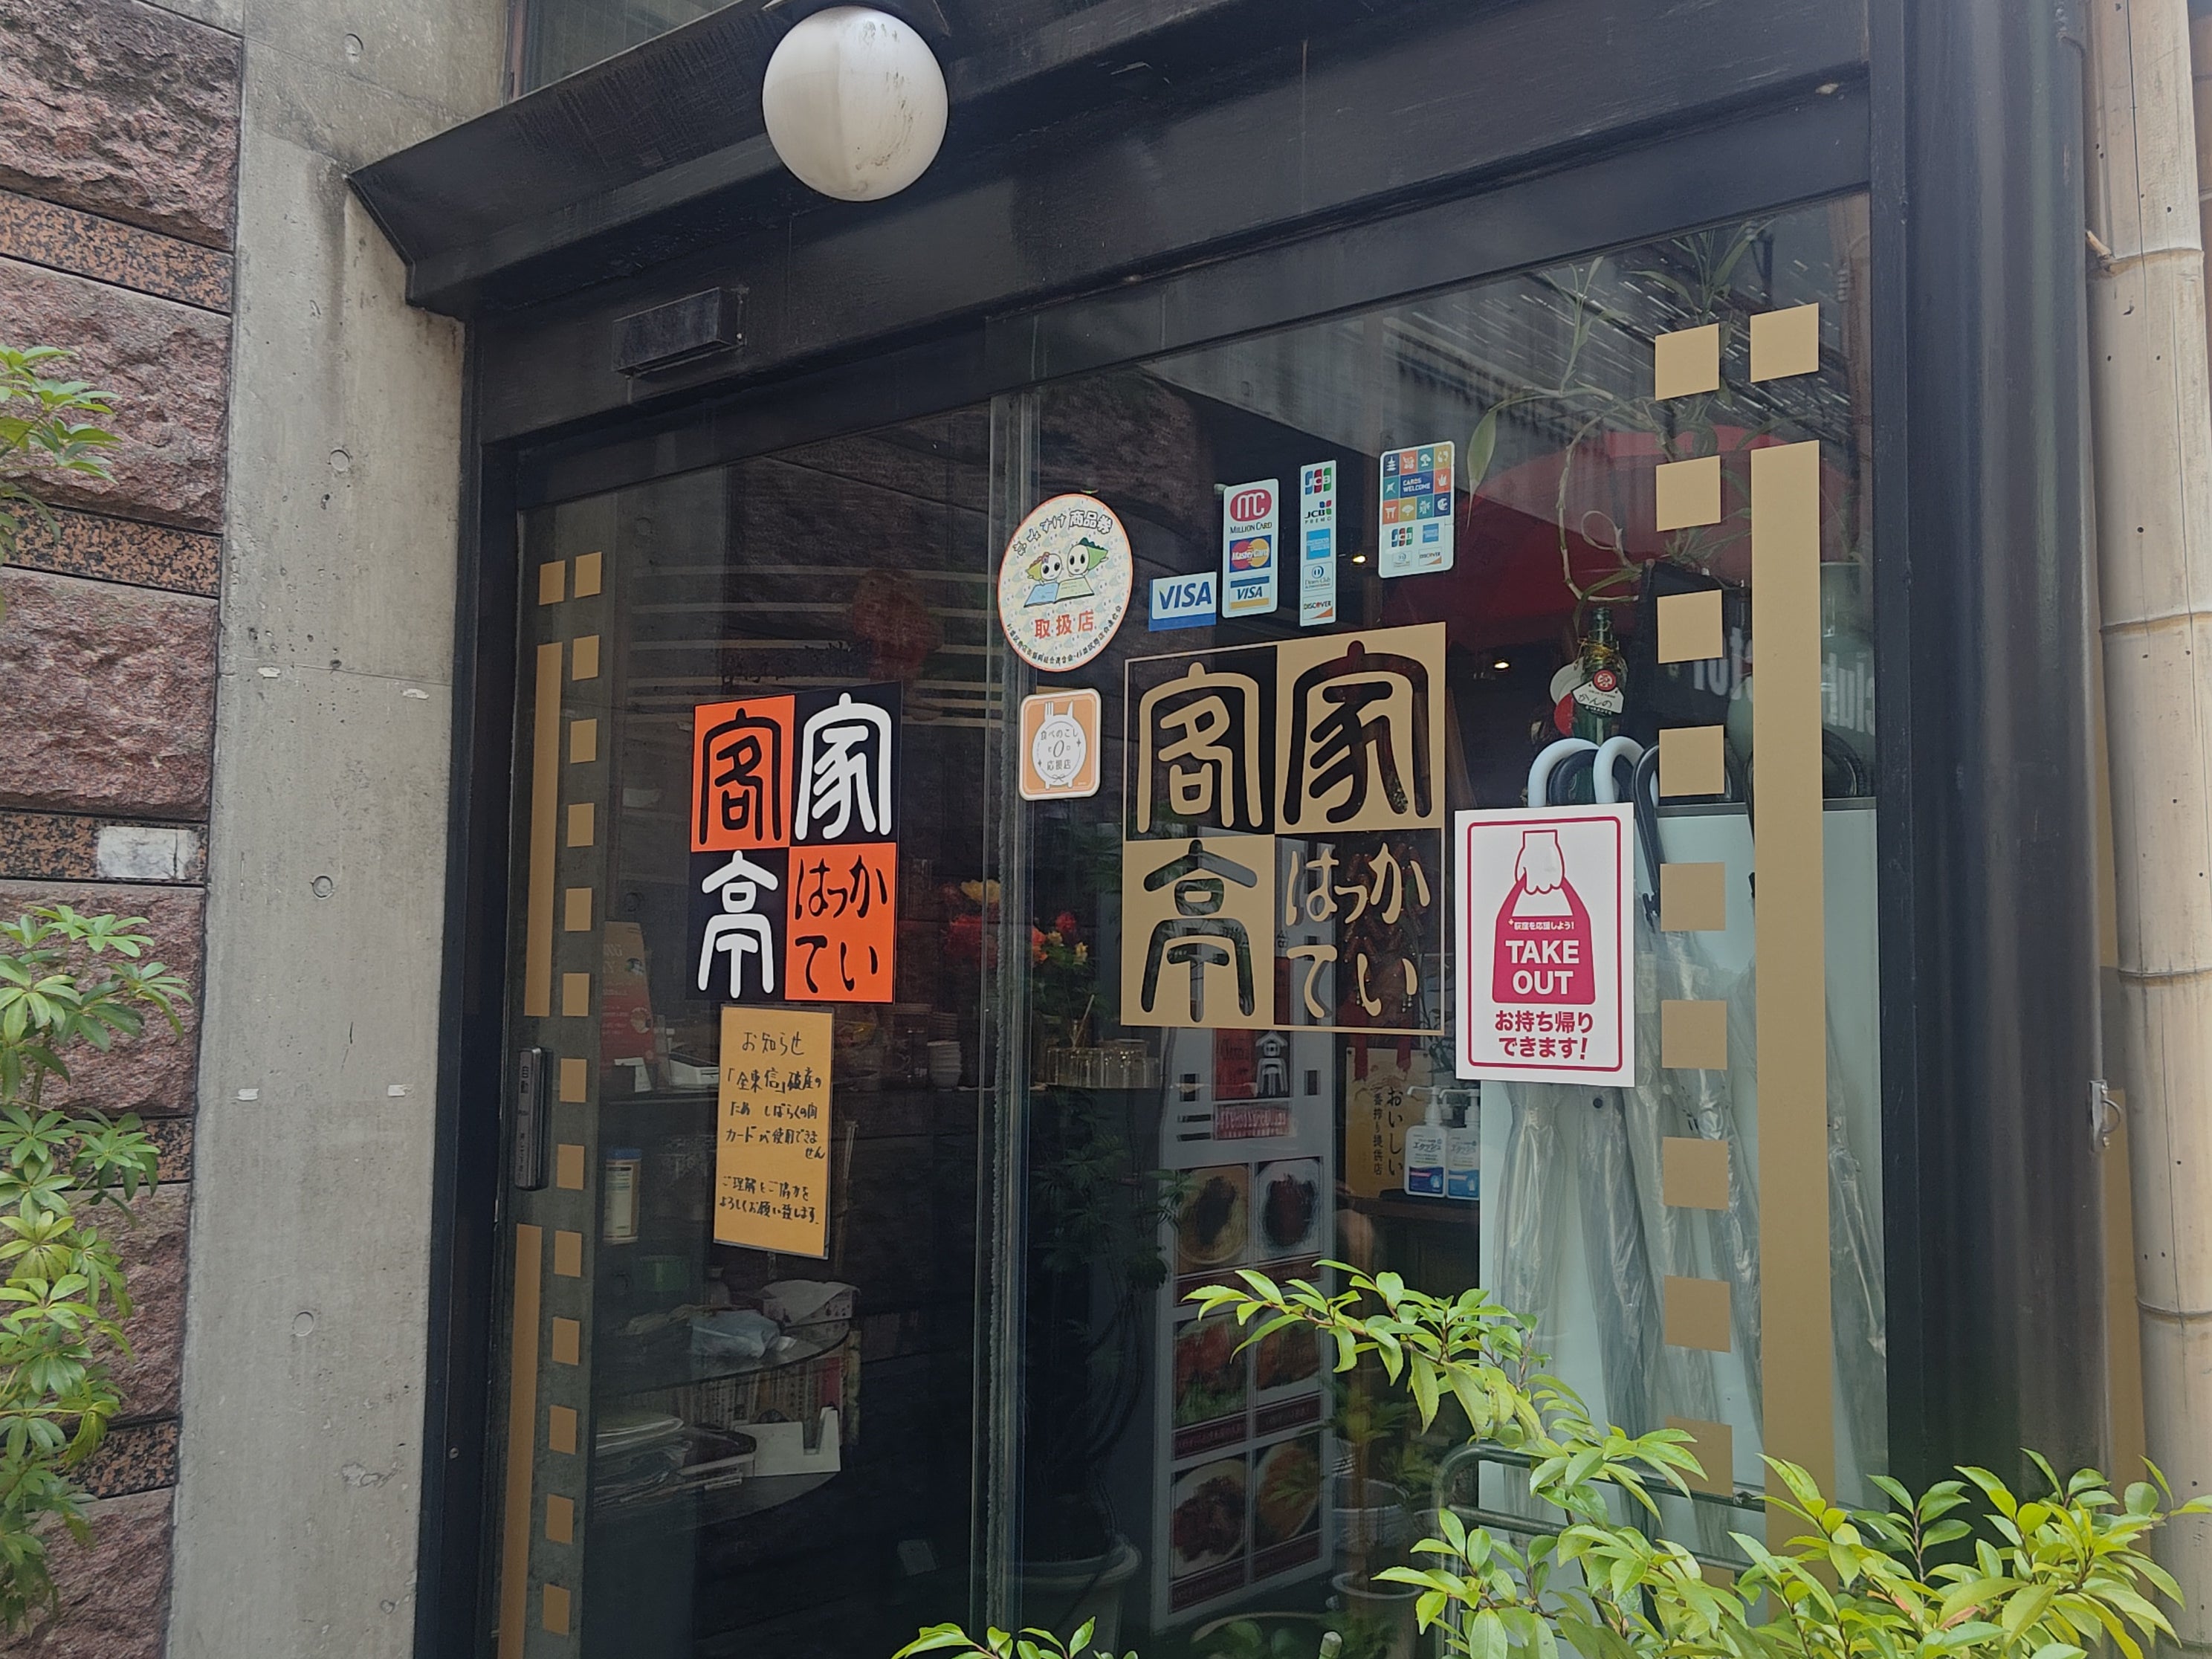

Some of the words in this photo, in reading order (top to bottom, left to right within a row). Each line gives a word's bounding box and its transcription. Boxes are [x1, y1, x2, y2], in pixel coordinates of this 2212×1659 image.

[1403, 478, 1422, 486] CARDS
[1403, 483, 1431, 493] WELCOME
[1230, 524, 1255, 534] MILLION
[1256, 522, 1272, 530] CARD
[1157, 581, 1212, 610] VISA
[1237, 586, 1263, 600] VISA
[1303, 600, 1331, 610] DISCOVER
[1034, 610, 1095, 639] 取扱店
[1041, 728, 1078, 740] 食べのこし
[1047, 759, 1071, 771] 応援店
[794, 855, 888, 921] はっか
[1286, 842, 1432, 928] はっか
[795, 934, 879, 993] てい
[1505, 940, 1580, 964] TAKE
[1287, 944, 1418, 1018] てい
[1512, 970, 1574, 995] OUT
[1494, 1009, 1594, 1034] お持ち帰り
[741, 1031, 805, 1056] お知らせ
[1498, 1036, 1588, 1061] できます!
[1386, 1086, 1403, 1176] おいしい
[805, 1146, 826, 1160] せん
